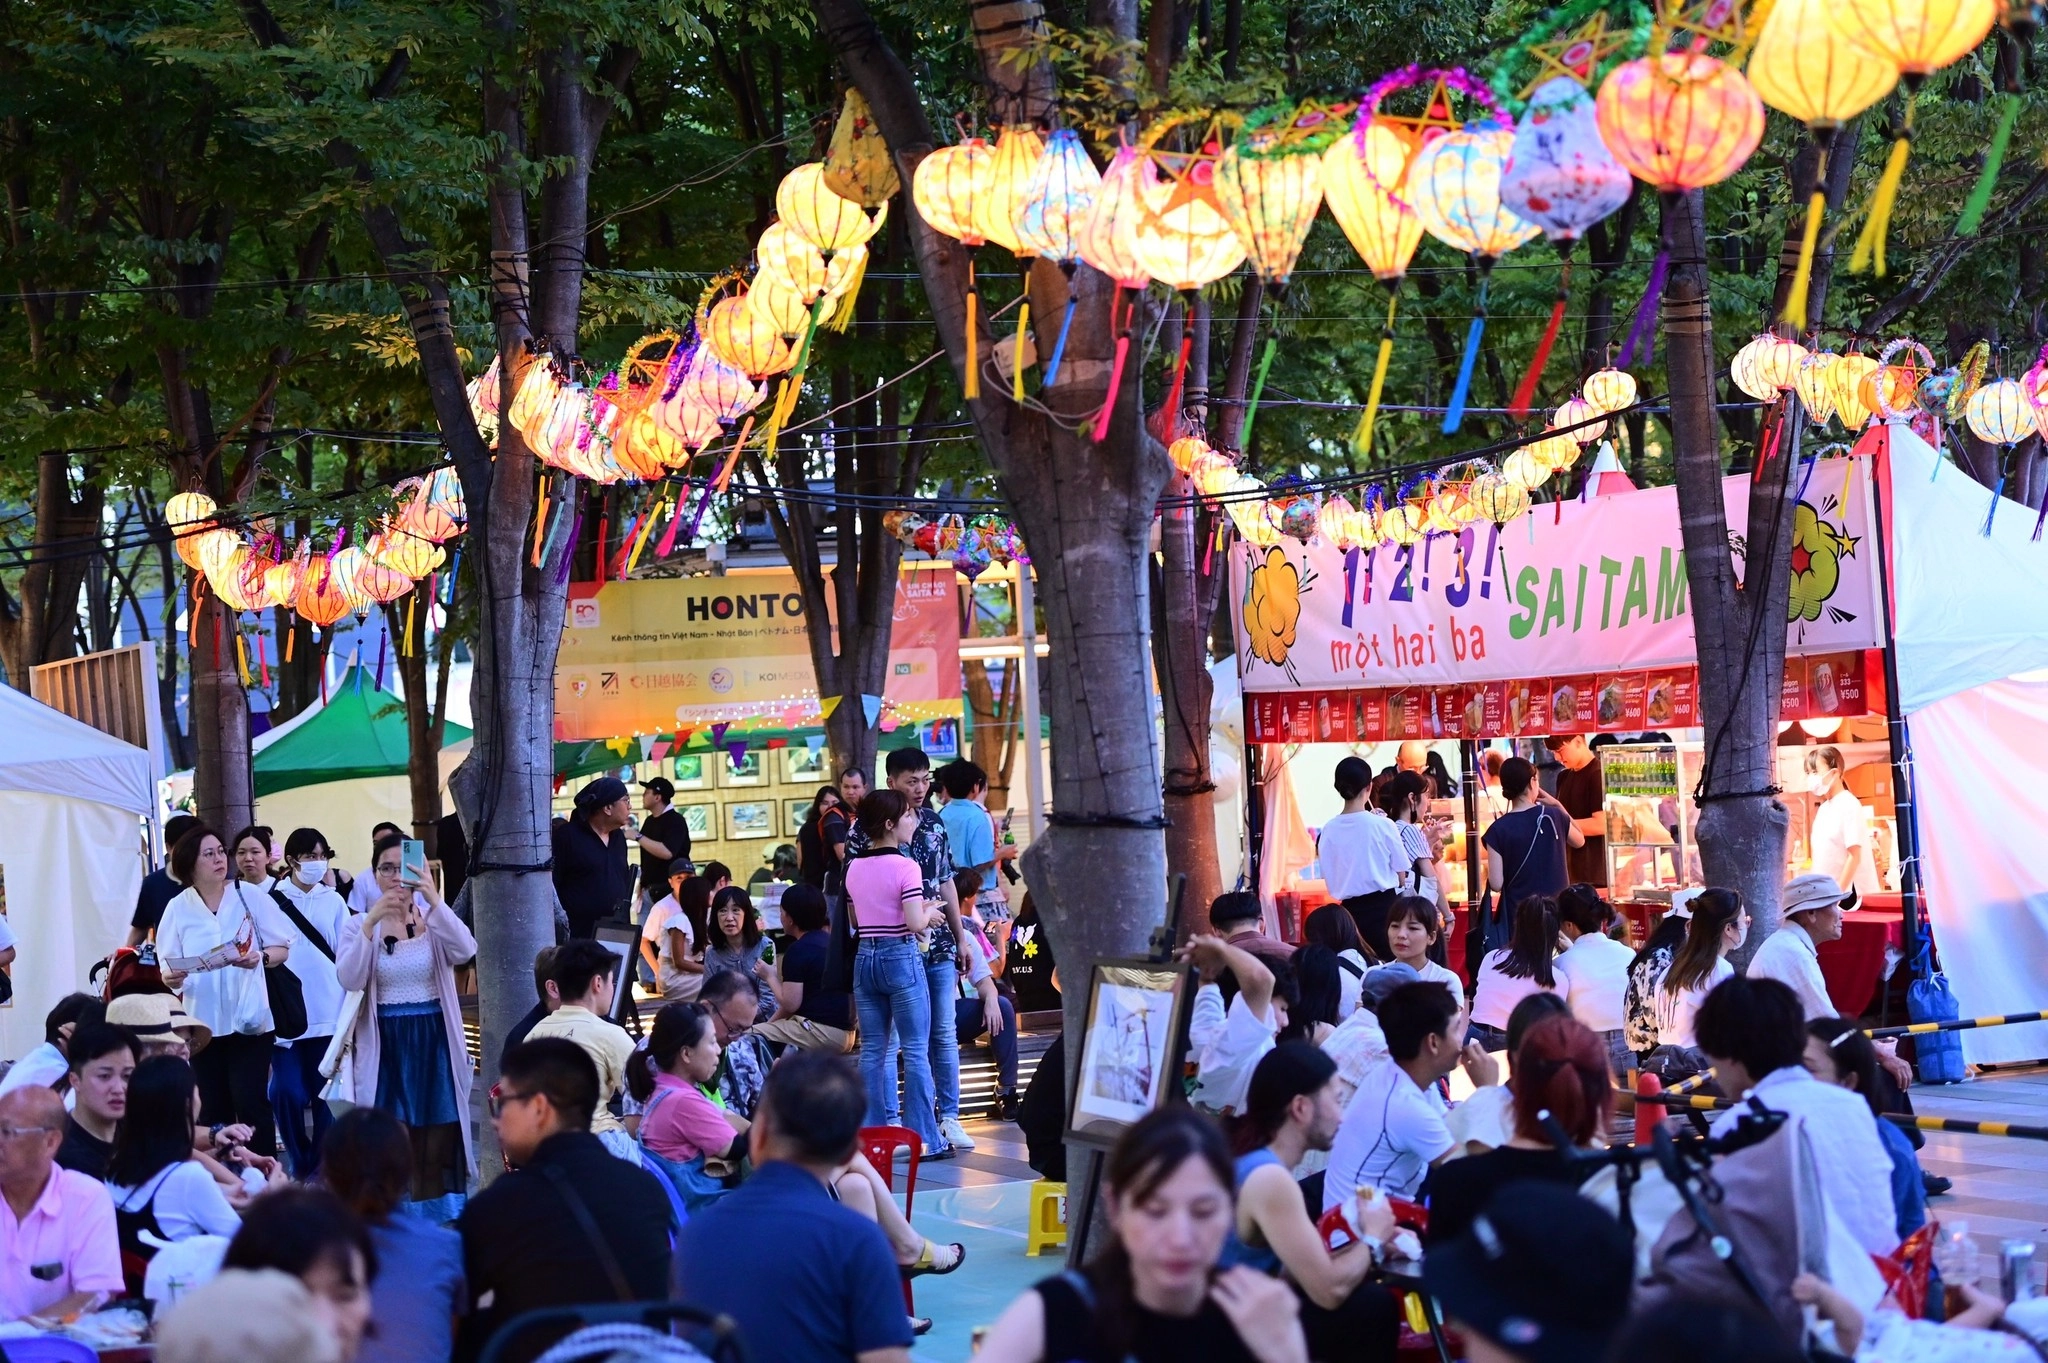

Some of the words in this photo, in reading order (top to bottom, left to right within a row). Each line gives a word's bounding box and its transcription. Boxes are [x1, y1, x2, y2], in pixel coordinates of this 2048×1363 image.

[687, 593, 805, 621] HONTO
[611, 632, 632, 642] Kênh
[660, 632, 670, 640] tin
[672, 631, 687, 642] Việt
[690, 631, 708, 639] Nam
[1331, 632, 1384, 678] một
[1393, 624, 1436, 668] hai
[1450, 615, 1486, 662] ba
[1782, 680, 1799, 688] aigon
[1840, 678, 1851, 686] 333
[1782, 686, 1799, 695] pecial
[1840, 689, 1859, 700] ¥500
[1782, 698, 1799, 708] ¥500
[1625, 707, 1641, 718] ¥600
[1674, 703, 1690, 714] ¥600
[1577, 710, 1592, 720] ¥600
[1486, 721, 1501, 730] ¥500
